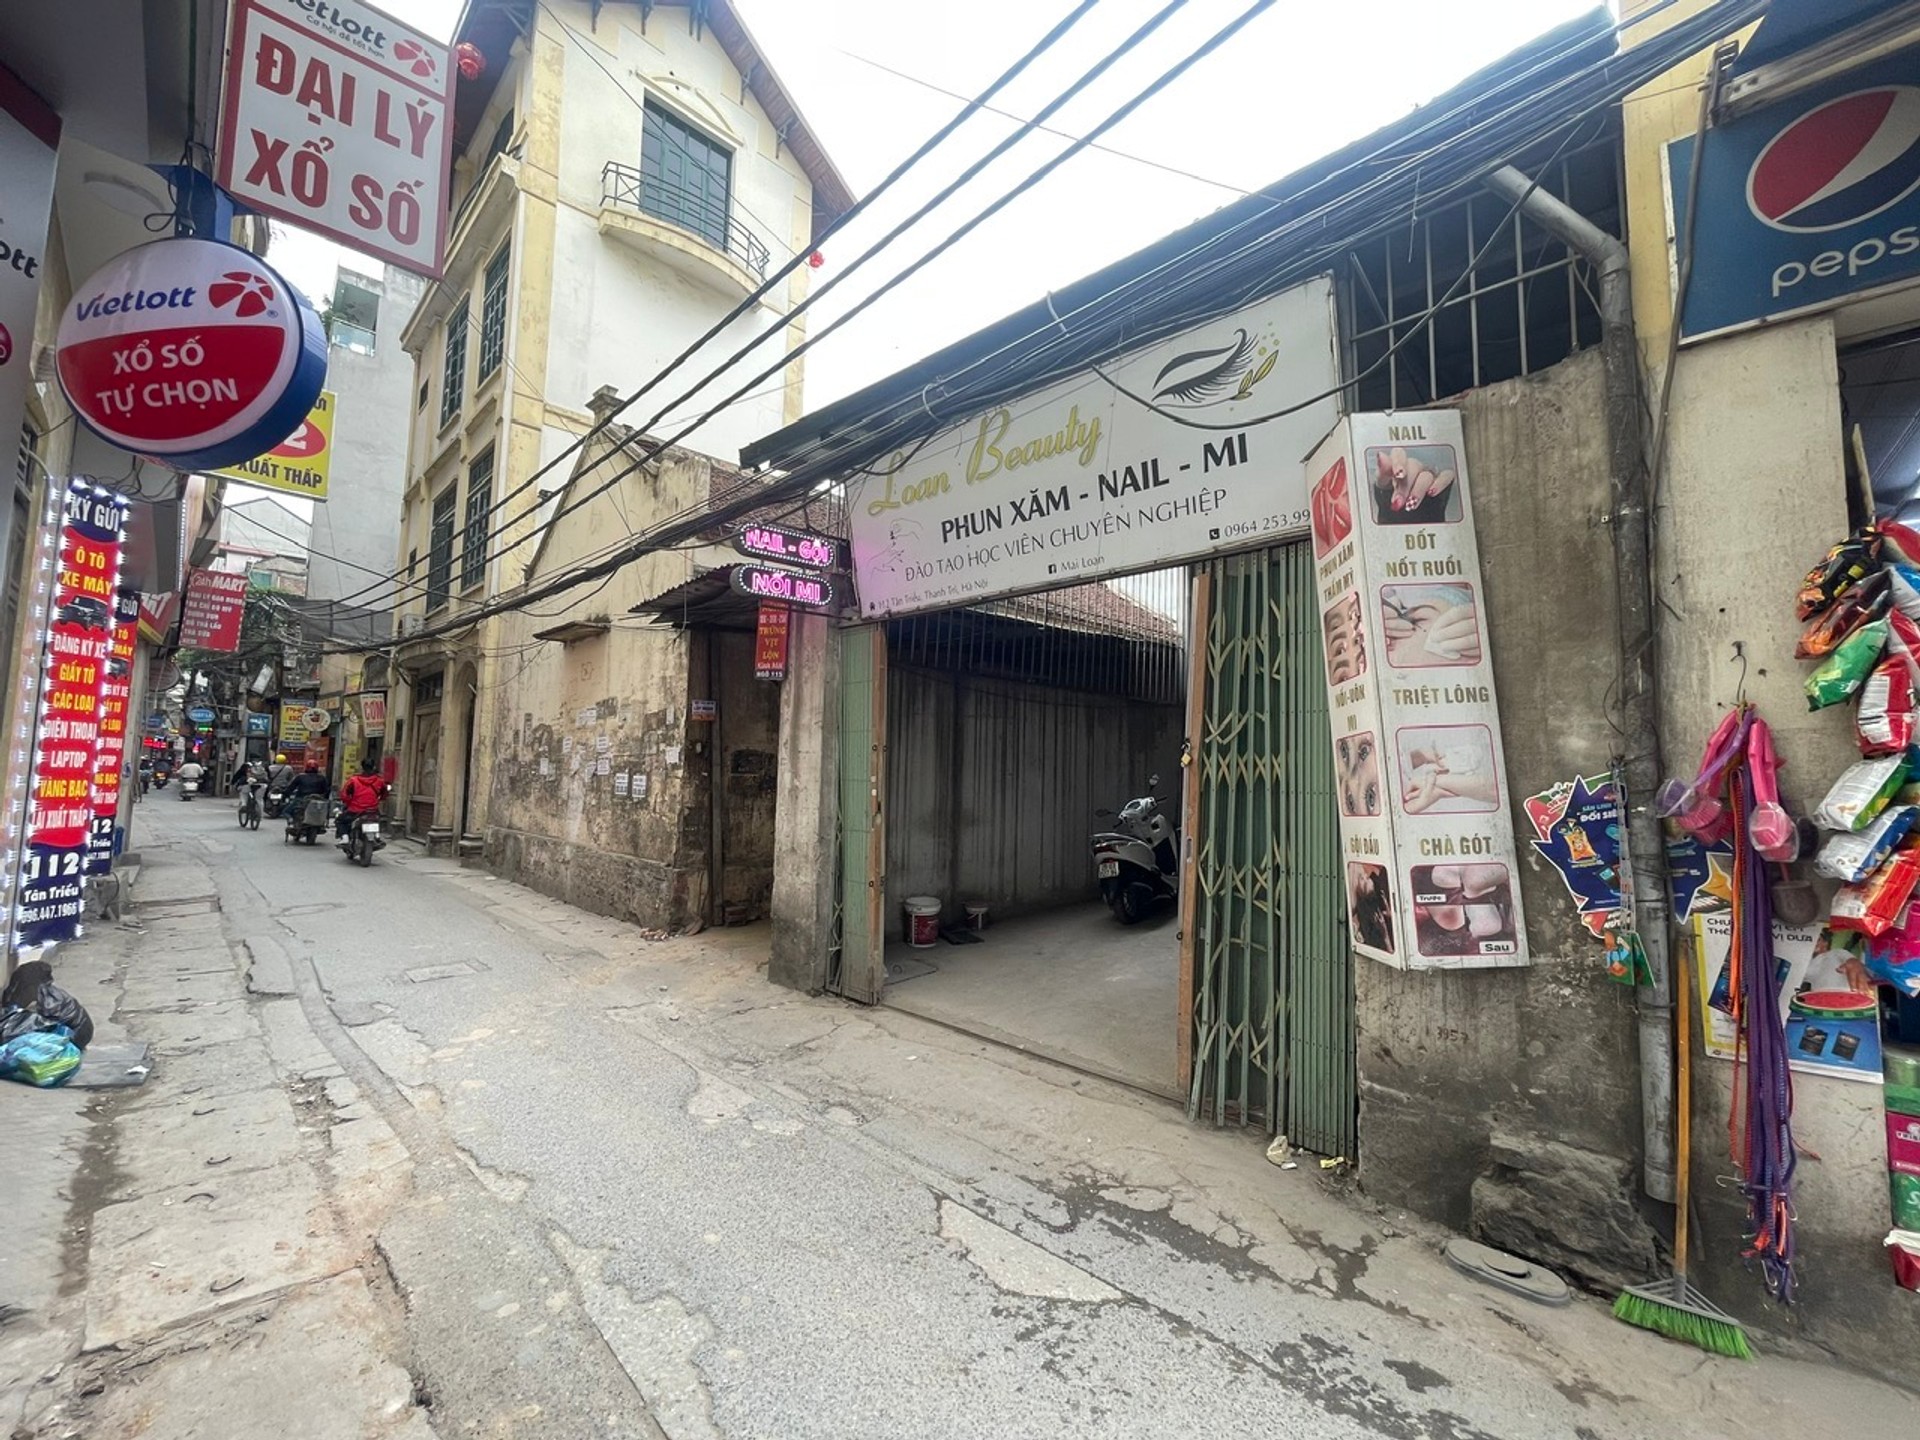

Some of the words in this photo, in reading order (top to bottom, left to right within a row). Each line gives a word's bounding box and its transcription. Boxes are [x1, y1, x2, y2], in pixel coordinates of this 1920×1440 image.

[256, 33, 356, 127] ĐẠI
[374, 89, 436, 159] LÝ
[245, 128, 335, 208] XỔ
[349, 173, 425, 245] SỐ
[77, 287, 196, 321] Vietlott
[113, 339, 153, 375] XỔ
[160, 335, 205, 369] SỐ
[96, 382, 135, 418] TỰ
[142, 378, 239, 409] CHỌN
[1388, 425, 1427, 441] NAIL
[868, 450, 951, 516] Loan
[966, 405, 1103, 486] Beauty
[284, 468, 323, 488] THẤP
[941, 505, 1002, 544] PHUN
[1009, 485, 1071, 526] XĂM
[1098, 458, 1170, 501] NAIL
[1203, 433, 1248, 473] MI
[69, 495, 91, 521] KÝ
[94, 502, 120, 532] GỬI
[905, 560, 934, 581] ĐÀO
[936, 555, 964, 575] TẠO
[968, 545, 1001, 567] HỌC
[1004, 533, 1044, 558] VIÊN
[1050, 511, 1131, 547] CHUYÊN
[1138, 488, 1227, 529] NGHIỆP
[1224, 520, 1257, 537] 0964
[1404, 528, 1436, 550] ĐỐT
[745, 529, 786, 553] NAIL
[76, 546, 86, 563] Ô
[89, 551, 105, 569] TÔ
[1386, 556, 1421, 577] NỐT
[62, 570, 80, 589] XE
[83, 574, 113, 596] MÁY
[212, 576, 246, 592] MART
[752, 571, 792, 596] NỐI
[795, 580, 821, 601] MI
[81, 638, 94, 656] KÝ
[94, 642, 106, 659] XE
[59, 660, 82, 682] GIẤY
[83, 664, 96, 684] TỜ
[53, 689, 72, 708] CÁC
[74, 696, 95, 715] LOẠI
[1393, 686, 1440, 708] TRIỆT
[1444, 686, 1490, 704] LÔNG
[70, 720, 97, 743] THOẠI
[1347, 714, 1357, 731] MI
[51, 751, 87, 768] LAPTOP
[39, 778, 67, 797] VÀNG
[68, 780, 88, 800] BẠC
[46, 803, 67, 828] XUẤT
[68, 803, 88, 827] THẤP
[1420, 836, 1456, 857] CHÀ
[1459, 836, 1492, 855] GÓT
[31, 852, 79, 879] 112
[24, 889, 47, 902] Tân
[1484, 943, 1509, 952] Sau
